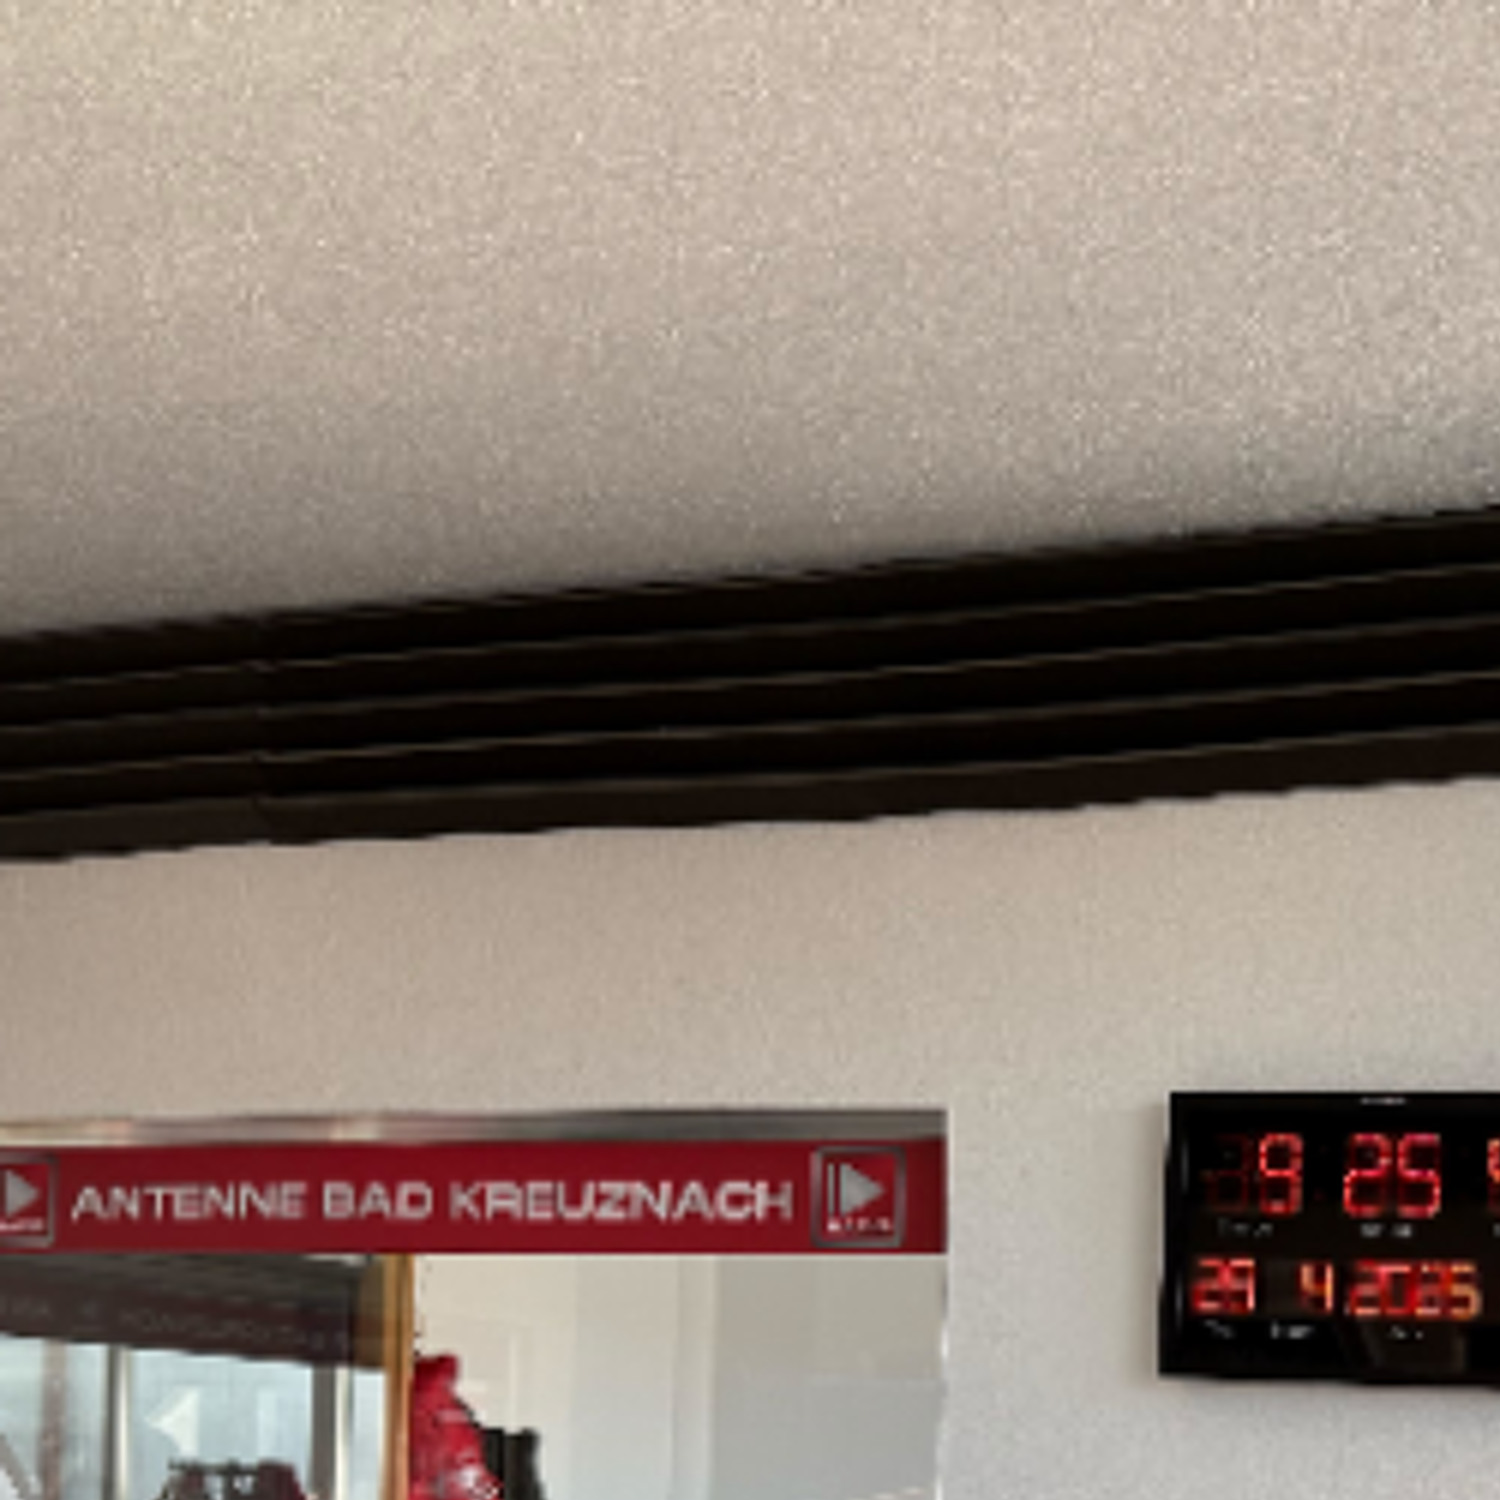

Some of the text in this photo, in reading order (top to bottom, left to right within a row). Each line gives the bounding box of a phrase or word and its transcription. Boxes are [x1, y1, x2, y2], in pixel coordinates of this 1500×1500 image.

[70, 1180, 794, 1222] ANTENNE BAD KREUZNACH
[1258, 1133, 1302, 1216] 9
[1344, 1133, 1441, 1218] 25
